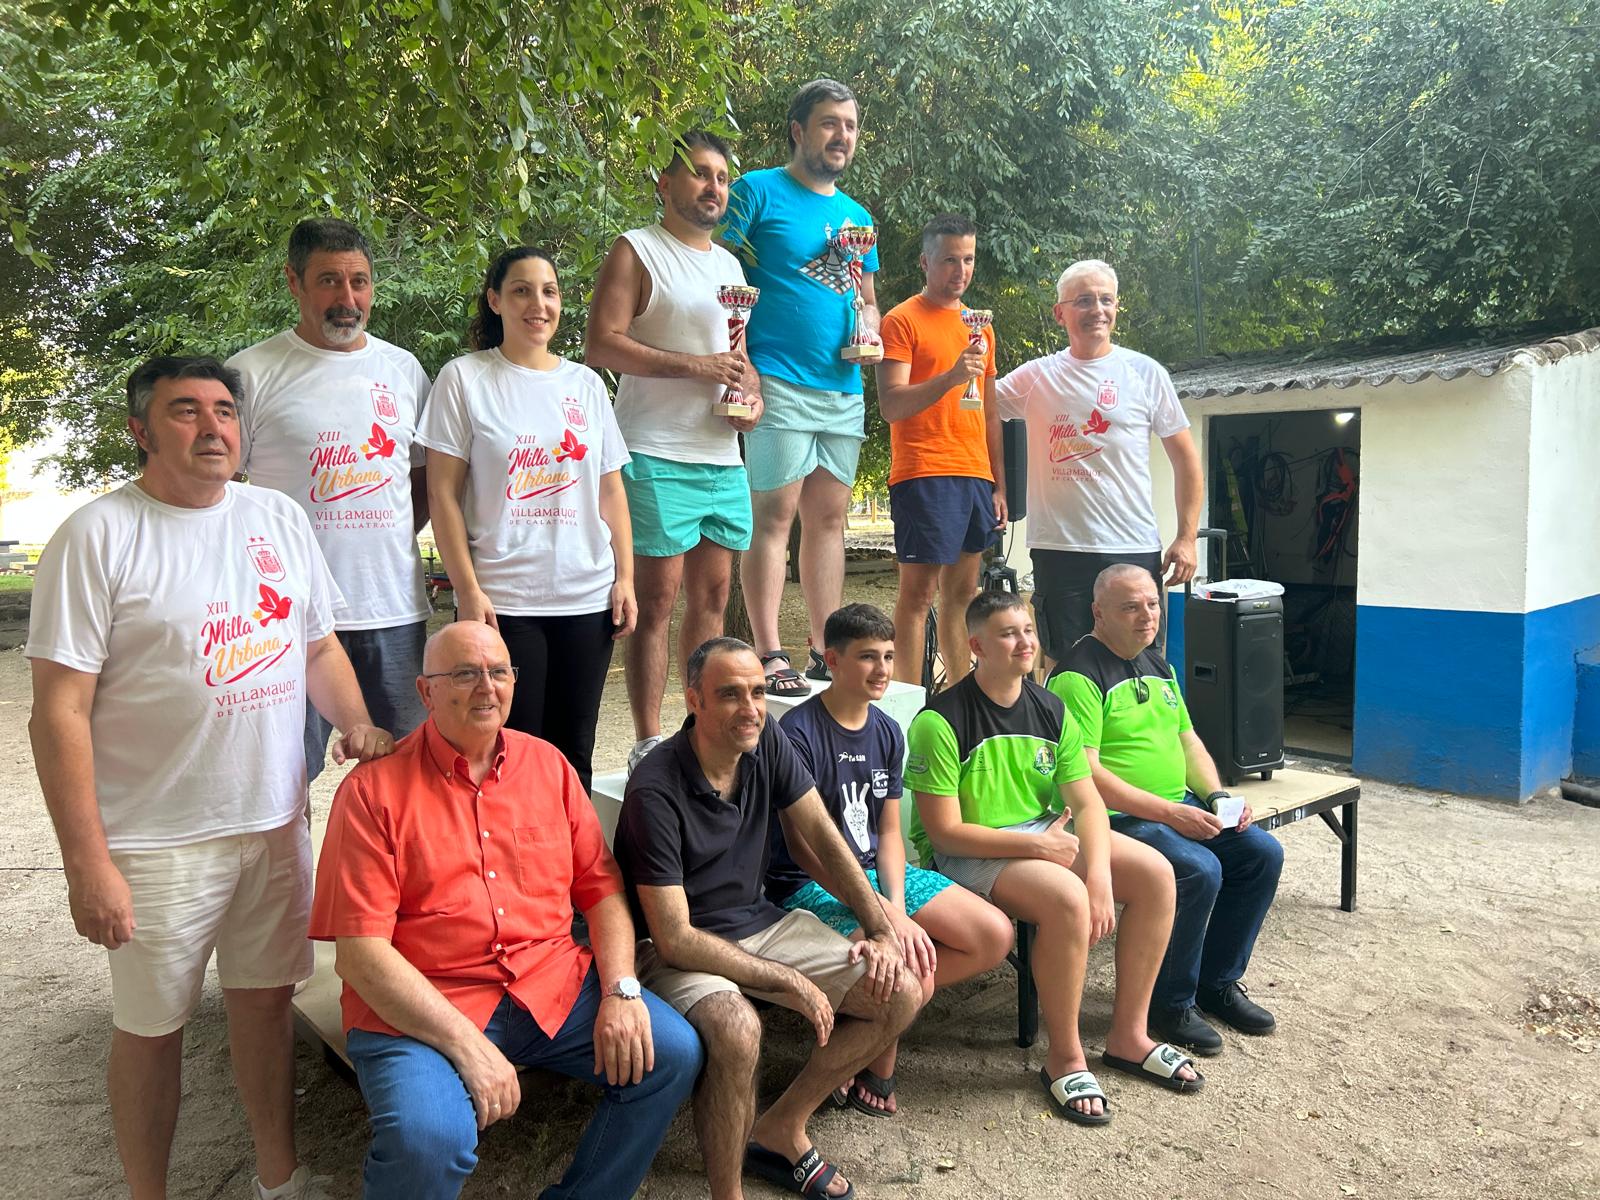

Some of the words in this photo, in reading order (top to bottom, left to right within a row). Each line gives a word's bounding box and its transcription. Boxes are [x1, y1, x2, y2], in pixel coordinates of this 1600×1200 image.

[317, 431, 340, 444] XIII
[516, 435, 536, 445] XIII
[1050, 424, 1078, 444] Milla
[309, 444, 358, 477] Milla
[508, 448, 550, 475] Milla
[319, 466, 382, 496] Urbana
[514, 468, 570, 494] Urbana
[206, 601, 228, 616] XIII
[201, 615, 254, 656] Milla
[214, 636, 281, 678] Urbana
[217, 709, 233, 718] DE
[242, 695, 296, 712] CALATRAVA
